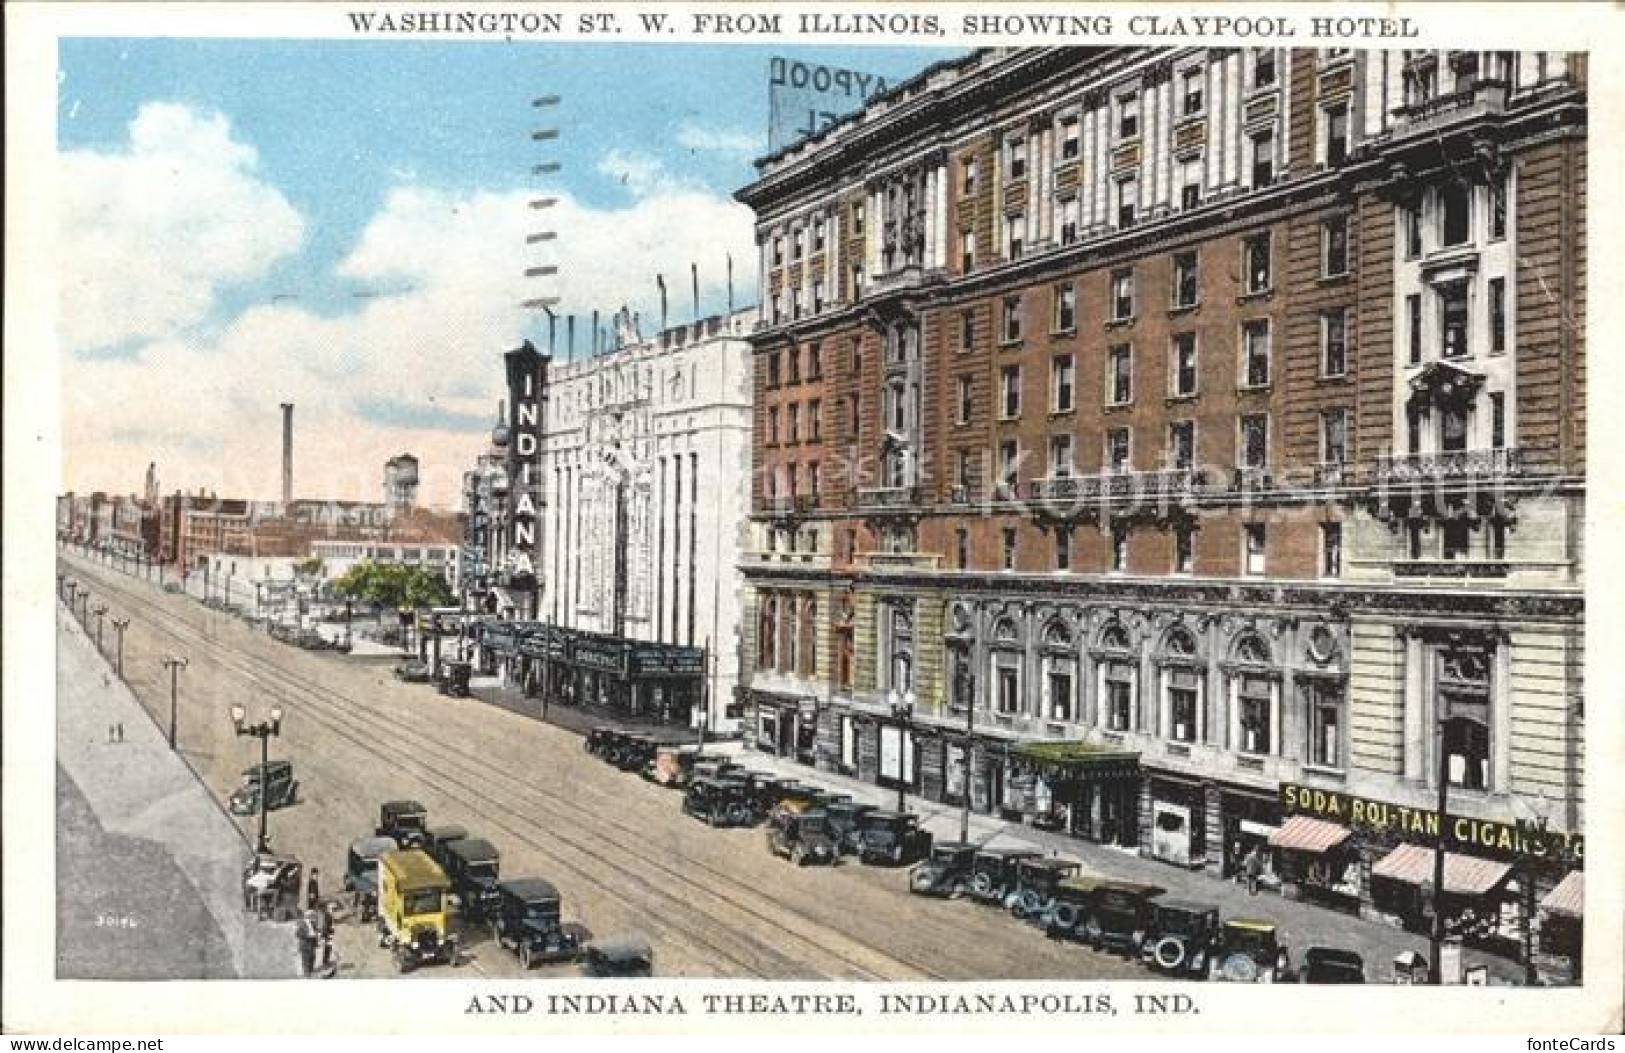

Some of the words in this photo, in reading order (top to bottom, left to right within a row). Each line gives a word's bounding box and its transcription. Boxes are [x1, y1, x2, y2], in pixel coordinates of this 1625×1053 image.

[350, 13, 561, 33] WASHINGTON
[579, 14, 621, 33] ST.
[640, 14, 674, 33] W.
[693, 14, 781, 33] FROM
[800, 14, 946, 36] ILLINOIS,
[962, 15, 1113, 36] SHOWING
[1128, 16, 1296, 37] CLAYPOOL
[1311, 18, 1419, 36] HOTEL
[516, 373, 538, 574] INDIANA
[1285, 785, 1340, 814] SODA
[466, 995, 533, 1014] AND
[549, 995, 686, 1014] INDIANA
[702, 995, 862, 1016] THEATRE,
[881, 995, 1117, 1016] INDIANAPOLIS,
[1134, 994, 1199, 1015] IND.
